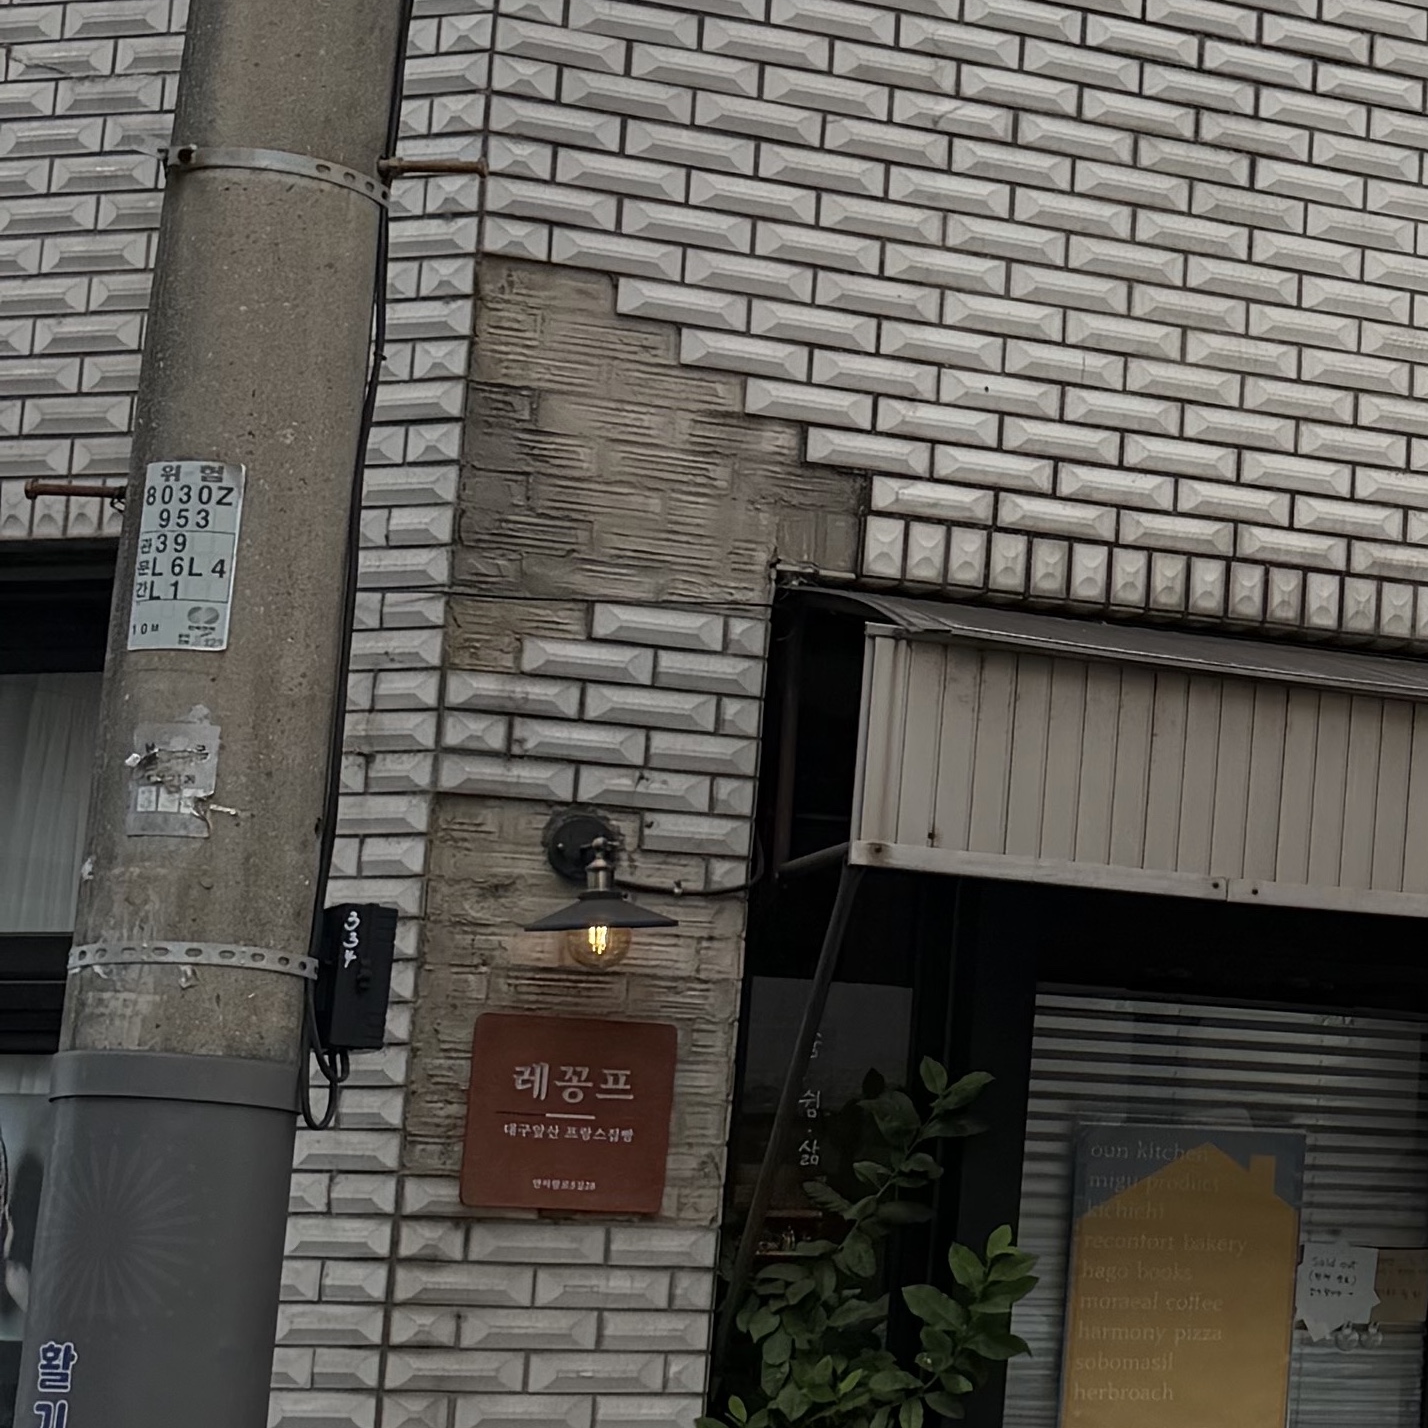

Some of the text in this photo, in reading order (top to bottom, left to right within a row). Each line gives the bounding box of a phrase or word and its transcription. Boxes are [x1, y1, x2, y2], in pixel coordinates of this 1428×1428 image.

[146, 484, 234, 506] 8030Z
[159, 508, 210, 528] 953
[513, 1061, 634, 1104] 레꽁프
[1174, 1325, 1222, 1347] pizza
